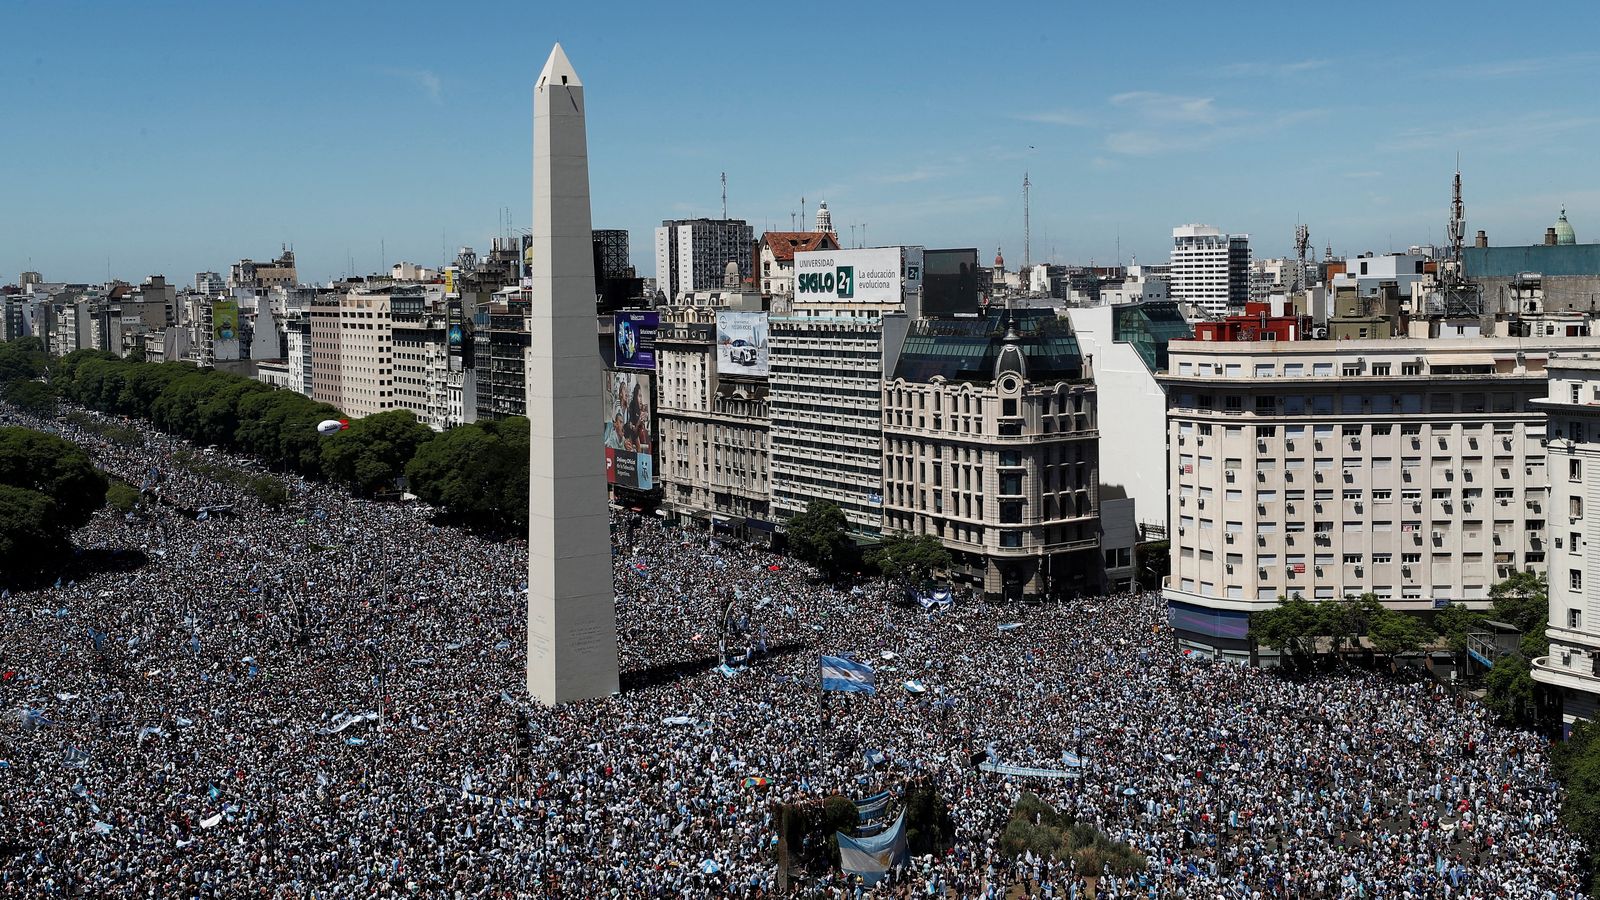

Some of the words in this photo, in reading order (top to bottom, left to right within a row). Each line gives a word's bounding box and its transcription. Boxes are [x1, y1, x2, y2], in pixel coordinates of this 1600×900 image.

[799, 259, 834, 268] UNIVERSIDAD
[858, 270, 866, 279] La
[867, 269, 896, 279] educación
[909, 269, 918, 280] 21
[798, 272, 835, 293] SIGLO
[838, 271, 851, 295] 21
[859, 280, 890, 289] evoluciona
